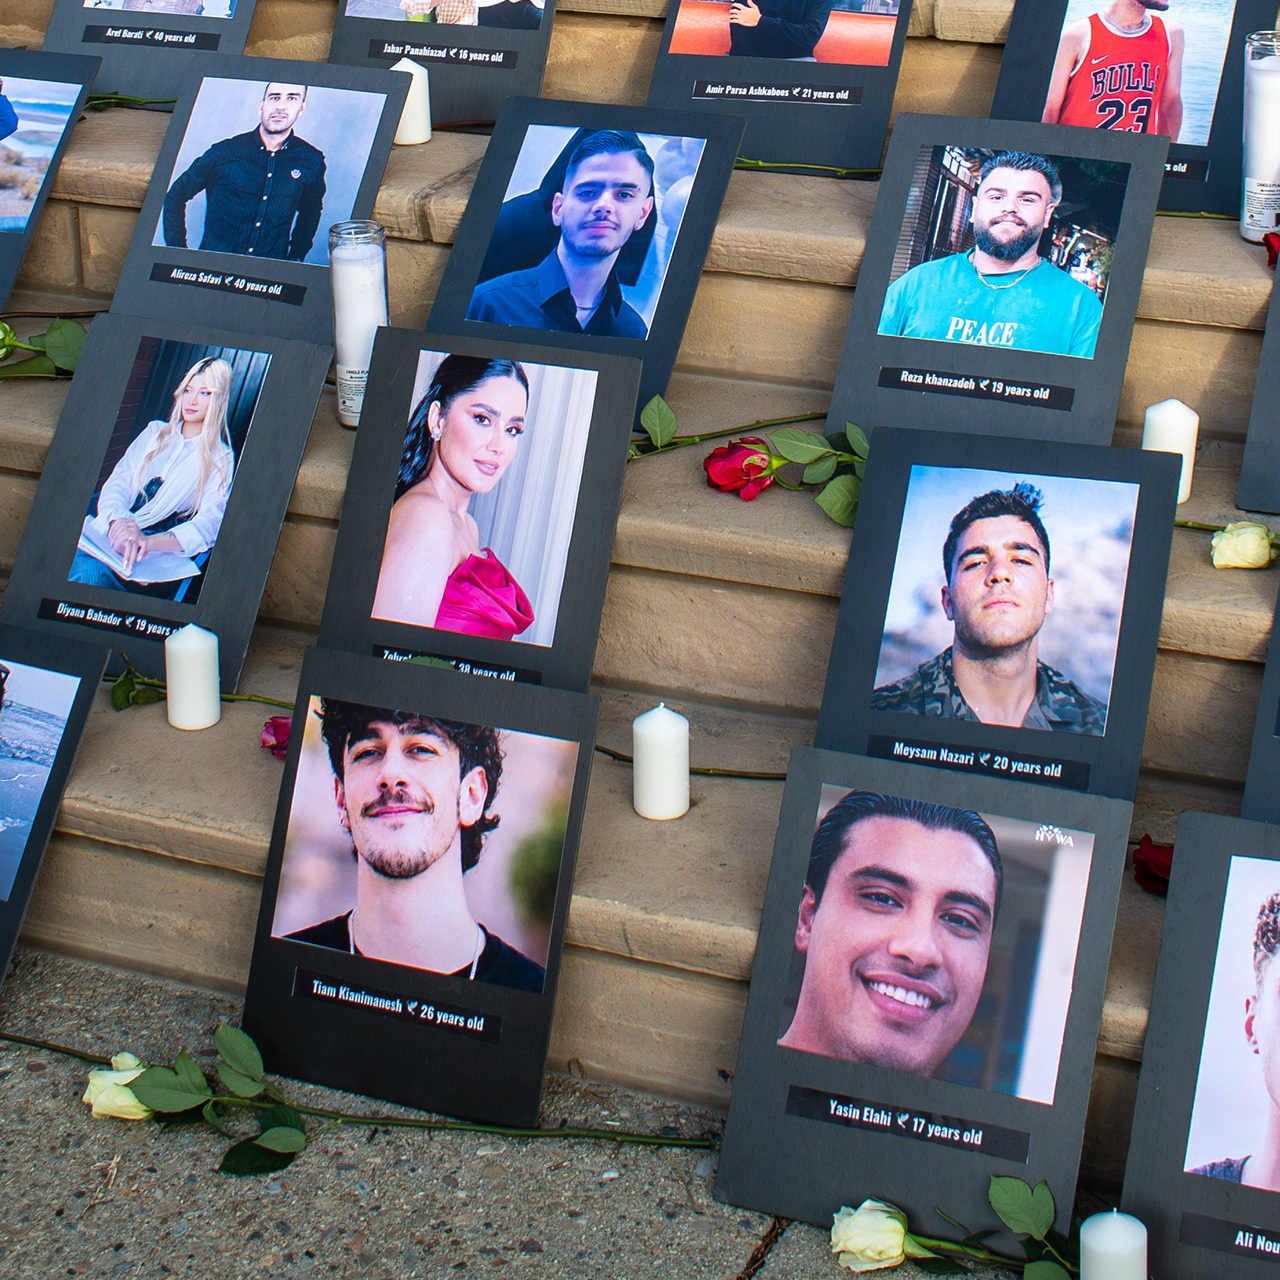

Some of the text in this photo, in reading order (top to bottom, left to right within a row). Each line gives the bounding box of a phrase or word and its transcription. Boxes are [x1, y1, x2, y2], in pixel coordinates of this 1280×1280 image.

[121, 29, 144, 39] Barati
[154, 31, 164, 41] 40
[164, 33, 183, 42] years
[184, 34, 197, 43] old
[383, 43, 403, 54] Jabar
[459, 49, 468, 59] 16
[469, 52, 489, 61] years
[490, 52, 503, 62] old
[706, 84, 849, 100] Amir Parsa Ashkaboos 21 years old
[1096, 97, 1152, 135] 23
[1172, 162, 1187, 172] old
[171, 268, 283, 295] Alireza Safavi 40 years old
[945, 316, 1018, 346] PEACE
[901, 370, 1050, 400] Reza khanzadeh 19 years old
[56, 602, 86, 618] Diyana
[86, 608, 122, 626] Bahador
[136, 618, 147, 630] 19
[146, 623, 170, 636] years
[893, 741, 1062, 778] Meysam Nazari 20 years old
[312, 979, 485, 1032] Tiam Kianimanesh 26 years old
[830, 1099, 983, 1146] Yasin Elahi 17 years old
[1235, 1230, 1254, 1248] Ali
